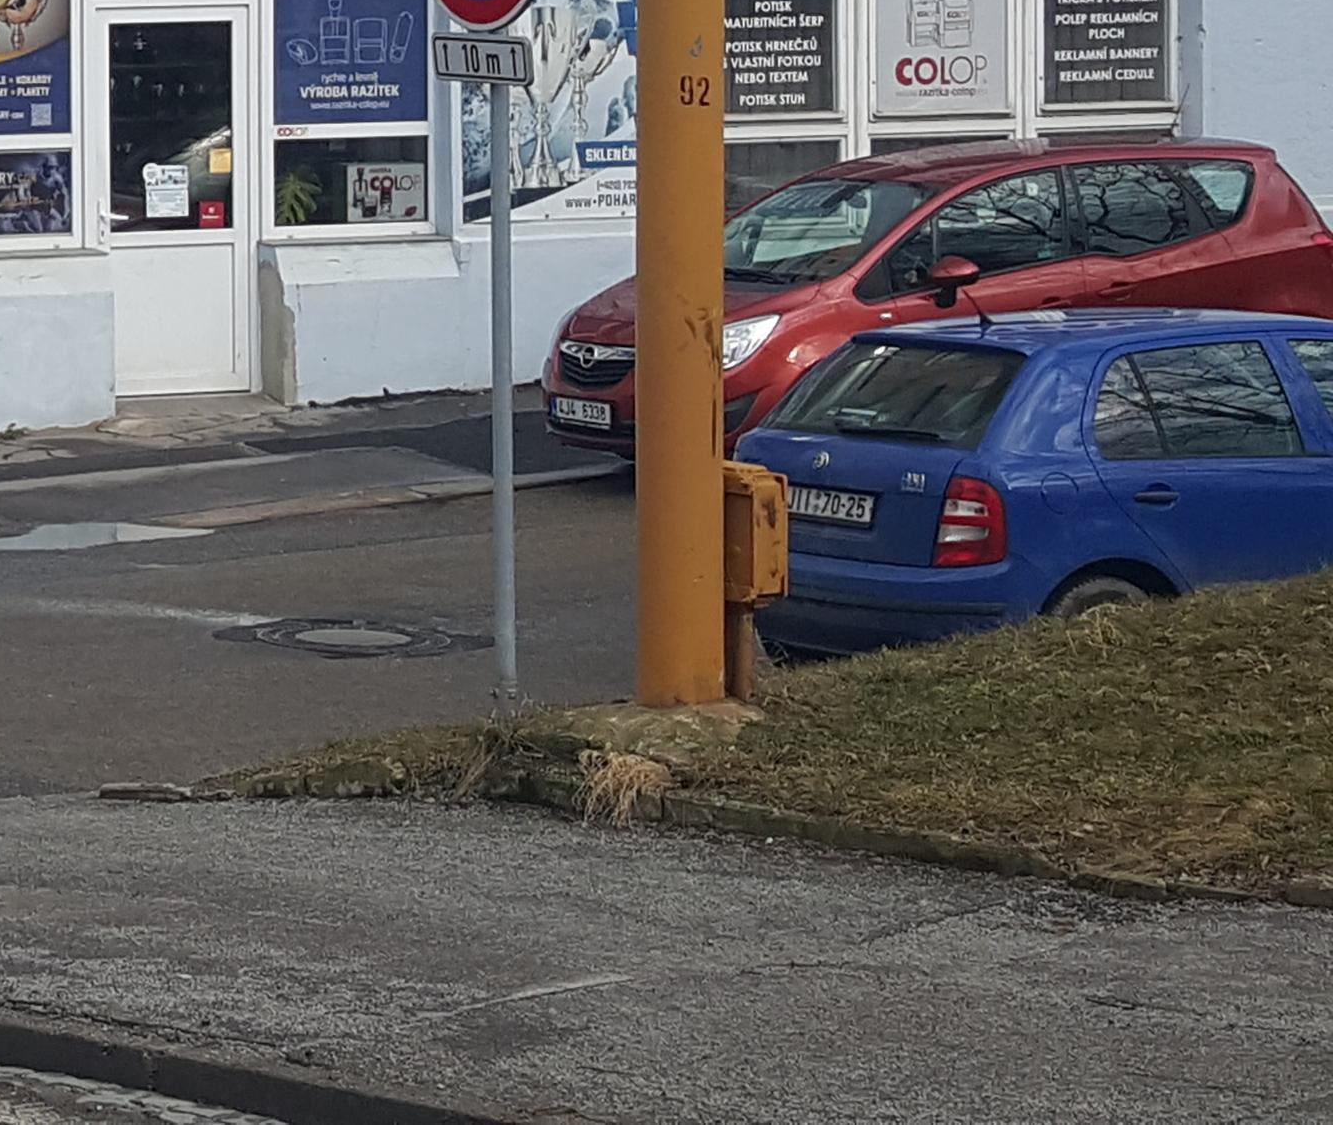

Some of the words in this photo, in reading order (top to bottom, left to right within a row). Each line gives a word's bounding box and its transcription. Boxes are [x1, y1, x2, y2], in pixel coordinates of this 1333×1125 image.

[754, 0, 792, 13] POTISK
[799, 13, 825, 27] ŠERP
[1055, 12, 1087, 25] POLEP
[1088, 27, 1125, 40] PLOCH
[725, 41, 762, 53] POTISK
[461, 43, 480, 73] 10
[485, 53, 501, 75] m
[732, 54, 775, 69] VLASTNÍ
[777, 55, 822, 68] FOTKOU
[735, 71, 766, 84] NEBO
[895, 55, 988, 87] COLOP
[300, 83, 348, 99] VÝROBA
[351, 82, 399, 98] RAZÍTEK
[680, 75, 710, 106] 92
[739, 94, 777, 107] POTISK
[821, 492, 867, 518] 70-25
